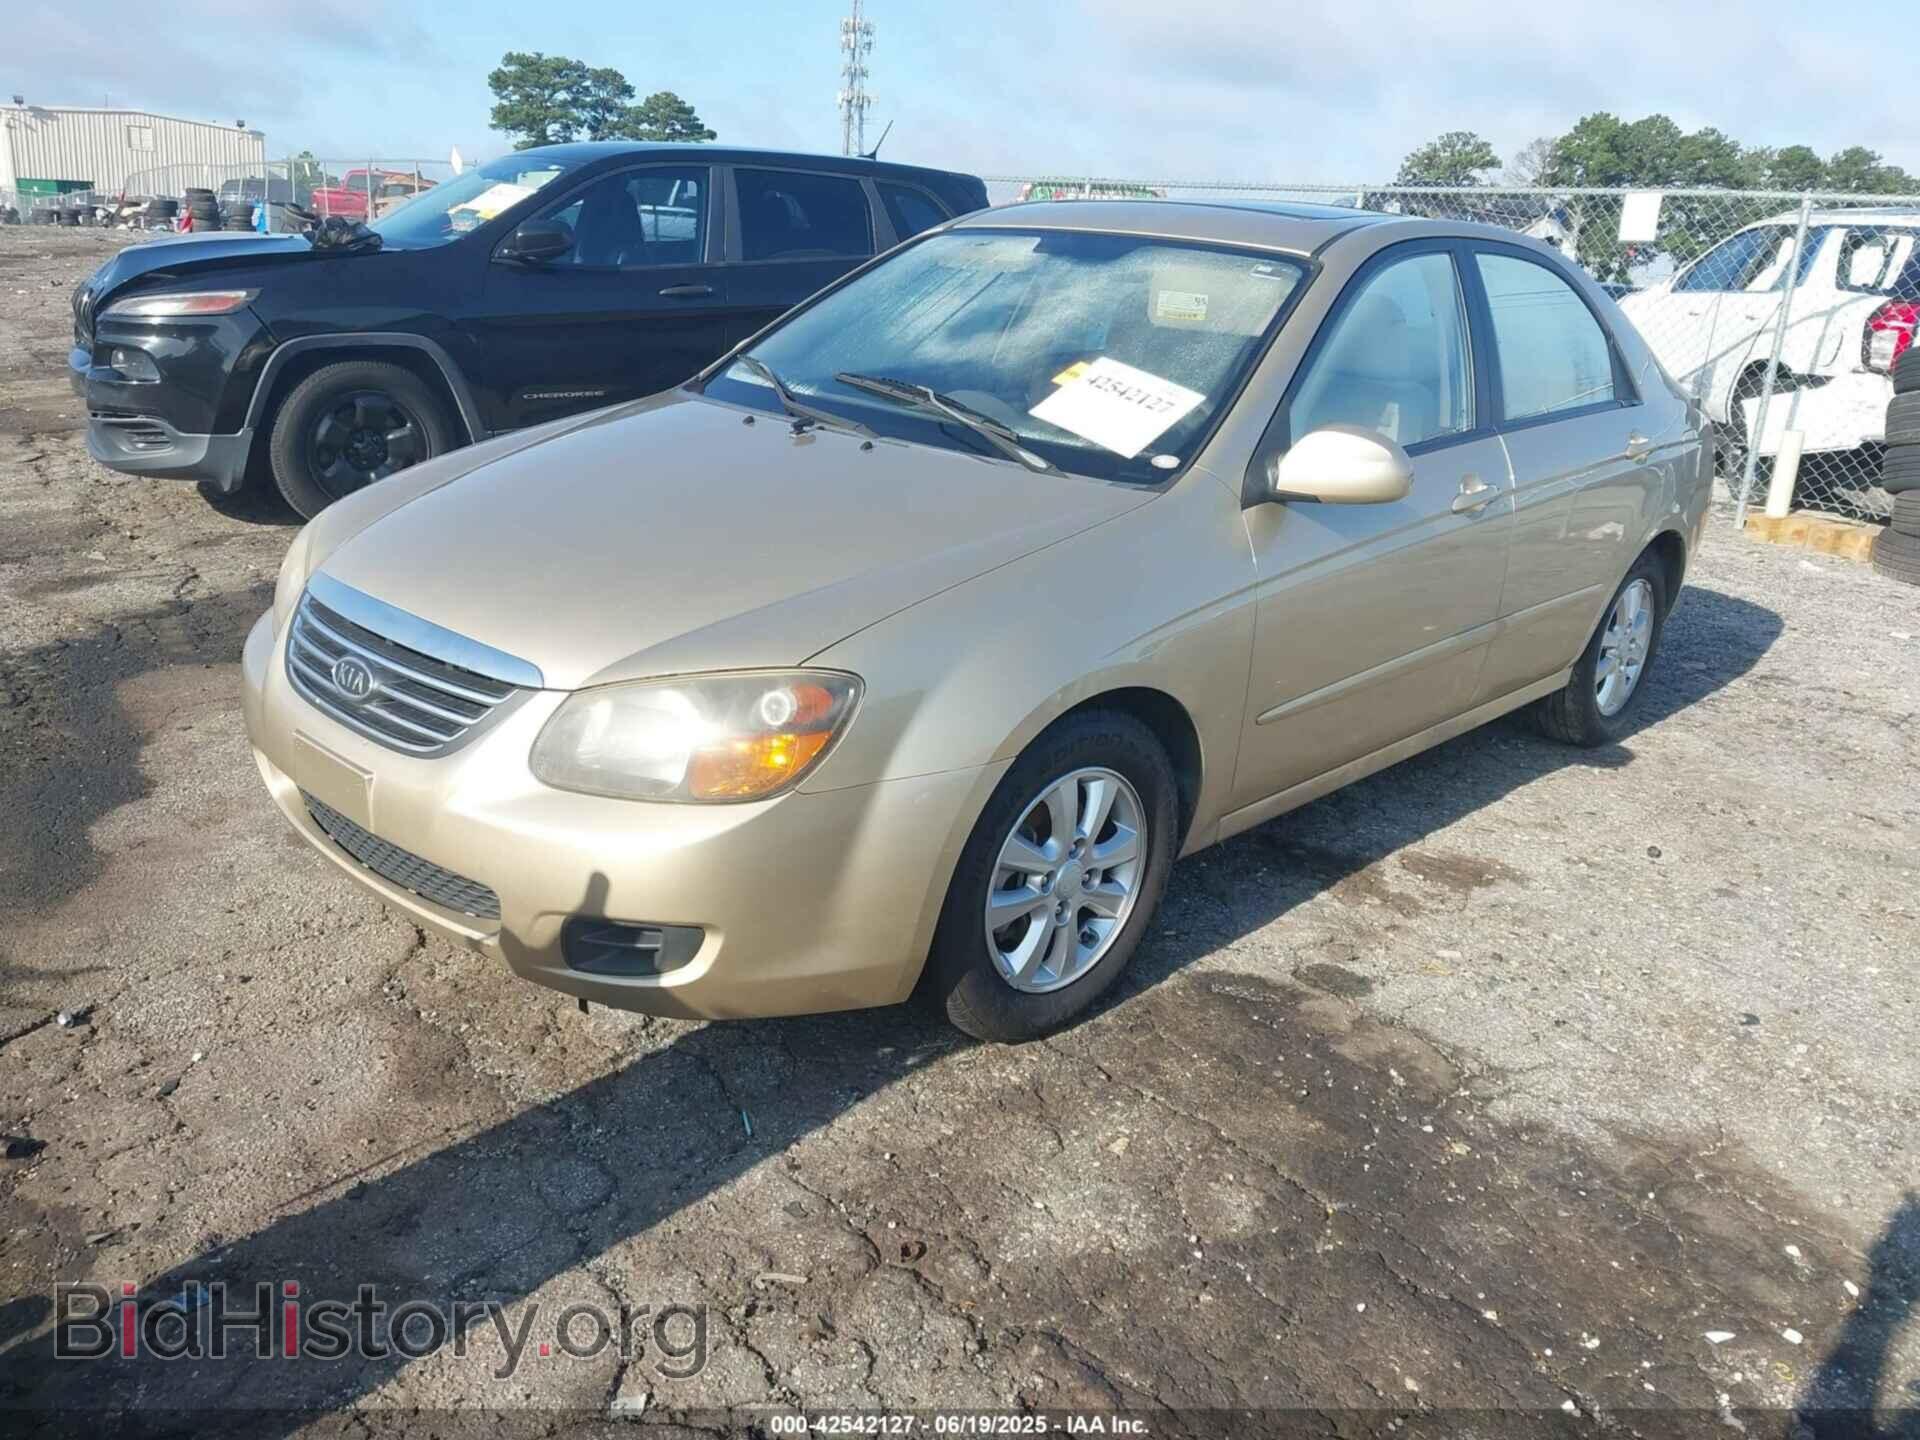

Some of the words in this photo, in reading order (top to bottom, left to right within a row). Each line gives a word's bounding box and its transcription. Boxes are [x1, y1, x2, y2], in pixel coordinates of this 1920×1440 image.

[522, 390, 605, 400] CHEROKEE
[1088, 375, 1175, 412] 42542127
[337, 662, 364, 694] KIA
